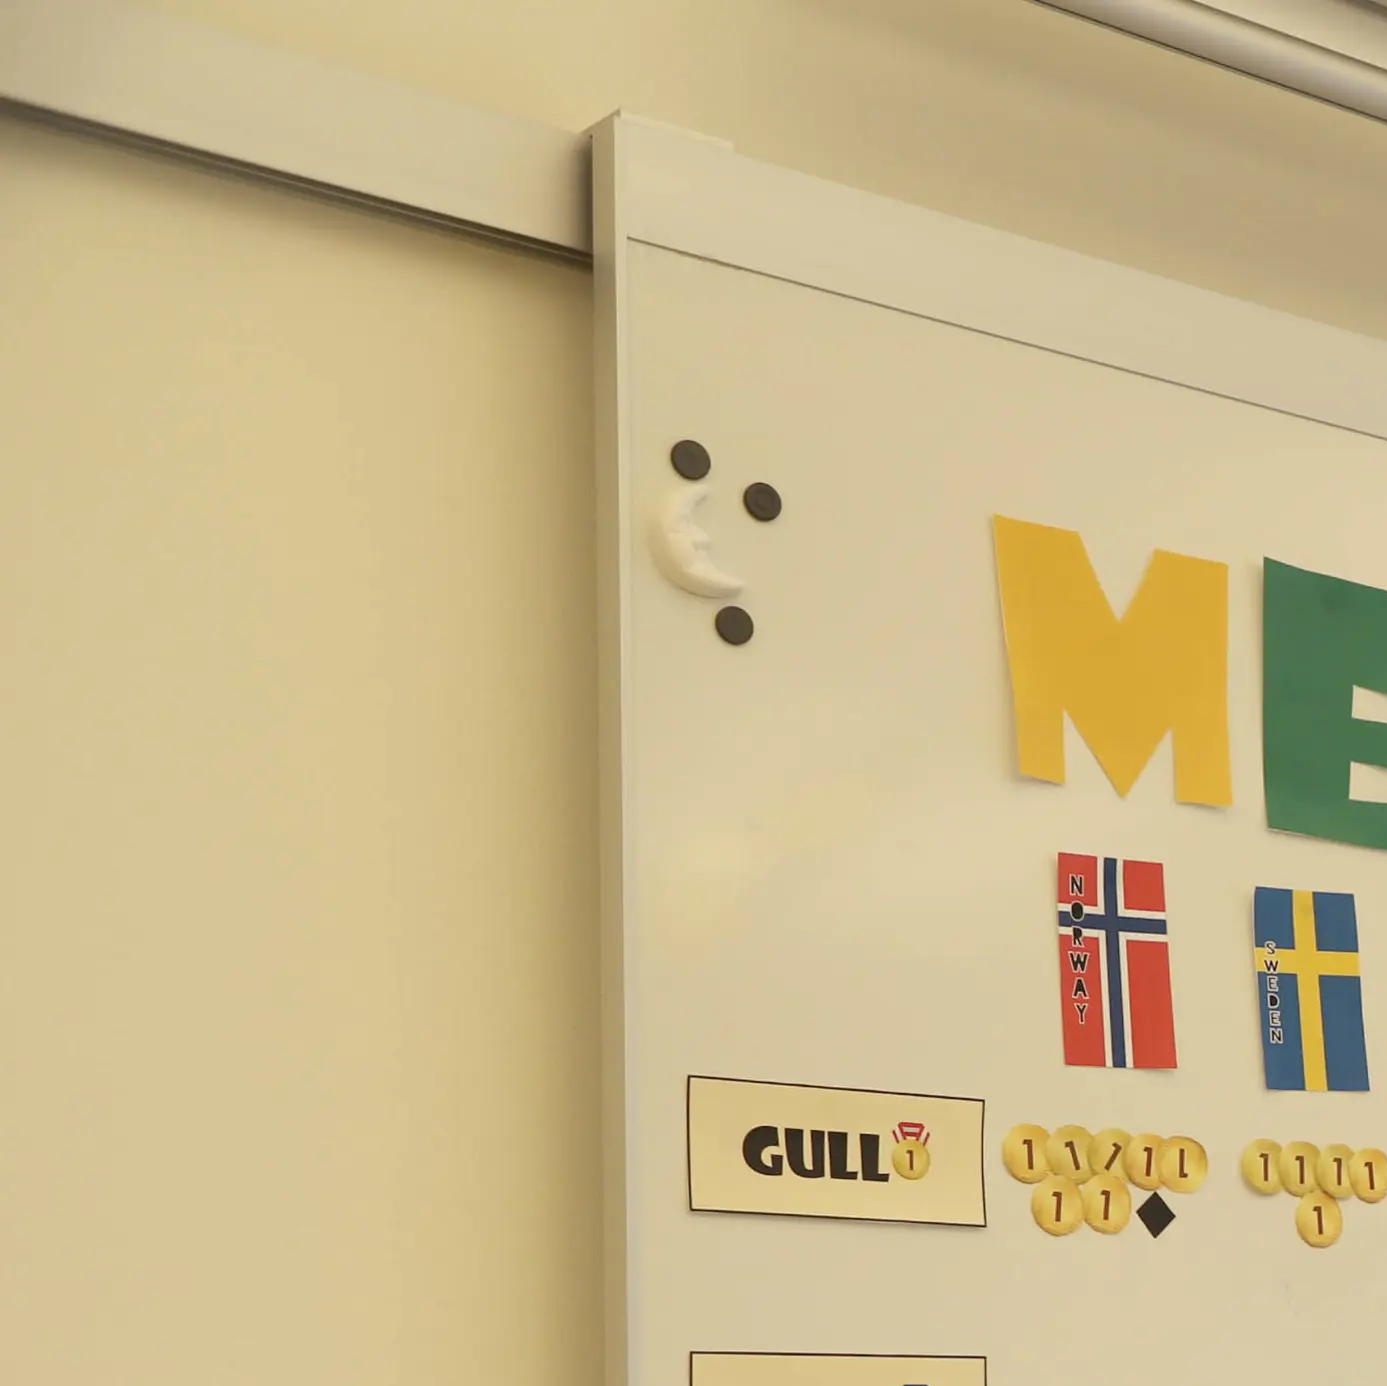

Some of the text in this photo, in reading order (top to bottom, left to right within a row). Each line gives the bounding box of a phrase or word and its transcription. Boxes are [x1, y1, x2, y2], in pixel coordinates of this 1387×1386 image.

[1068, 874, 1090, 1026] NORWAY
[1263, 940, 1284, 1044] SWEDEN
[742, 1125, 916, 1183] GULL 1
[1021, 1137, 1190, 1180] 1 1 1 1 1
[1258, 1151, 1376, 1192] 1 1 1 1
[1050, 1188, 1112, 1224] 1 1
[1311, 1204, 1325, 1236] 1
